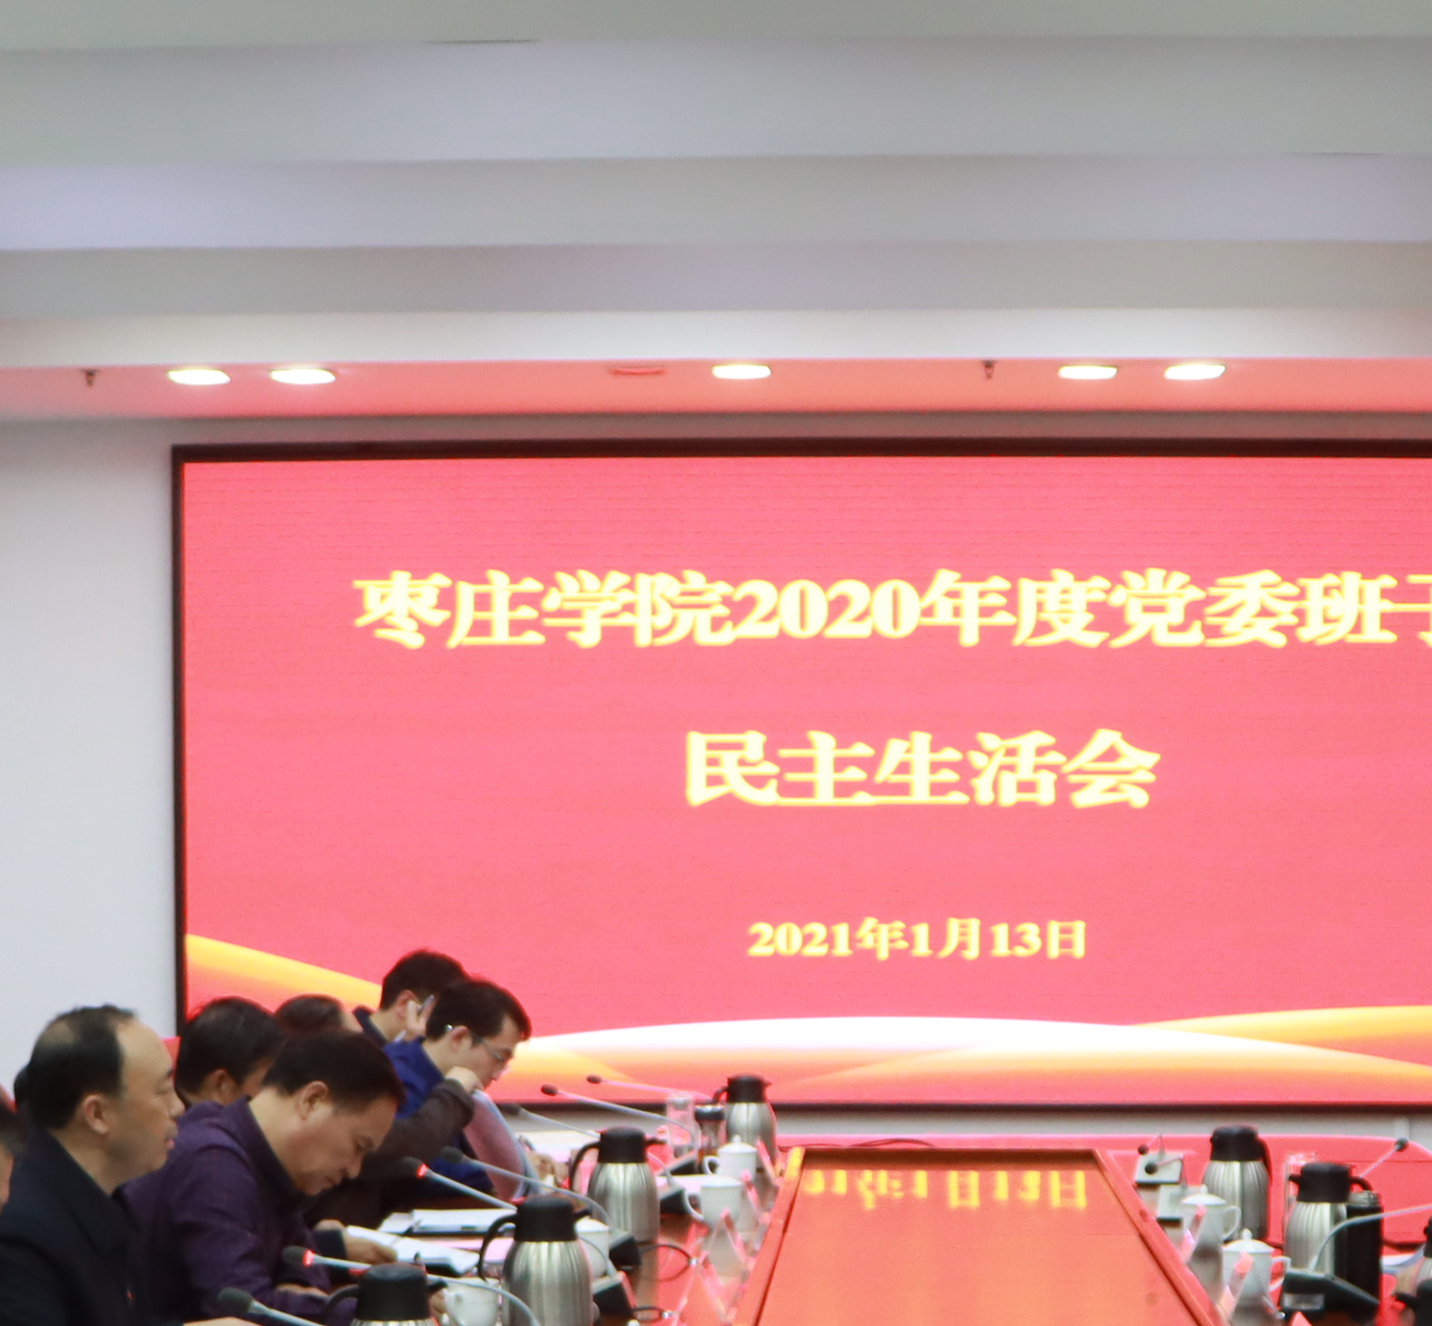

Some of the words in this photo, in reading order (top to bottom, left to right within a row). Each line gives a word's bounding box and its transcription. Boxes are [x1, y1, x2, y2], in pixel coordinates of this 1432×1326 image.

[684, 727, 1162, 809] 民主生活会
[747, 915, 1088, 960] 2021年1月13日
